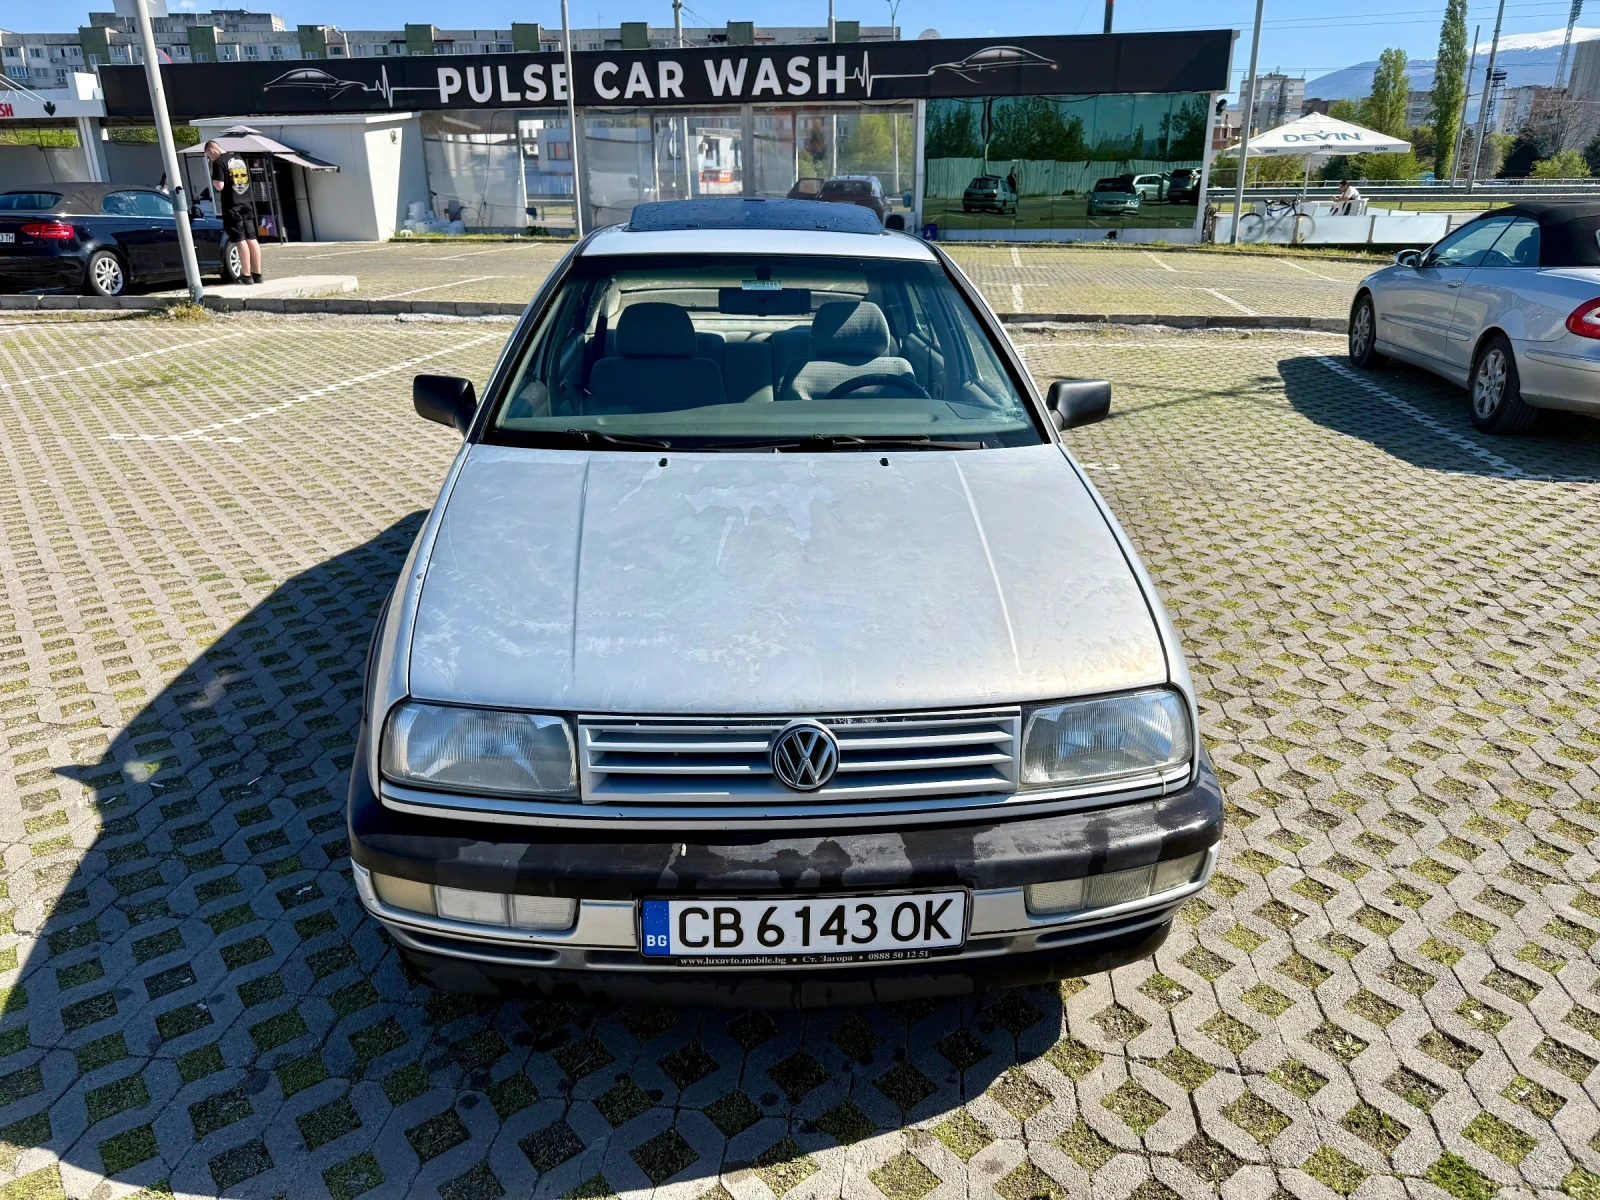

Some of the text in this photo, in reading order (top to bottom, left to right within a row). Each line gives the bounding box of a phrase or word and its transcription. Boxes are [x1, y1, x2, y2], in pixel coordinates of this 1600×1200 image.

[437, 55, 846, 103] PULSE CAR WASH
[1283, 131, 1361, 142] DEVIN
[679, 898, 954, 949] CB 6143 OK
[646, 934, 668, 947] BG
[680, 957, 787, 965] www.luxavto.mobile.bg
[820, 955, 853, 963] Загора
[868, 952, 890, 960] 0888
[892, 951, 903, 959] 50
[906, 950, 916, 958] 12
[918, 950, 929, 958] 51
